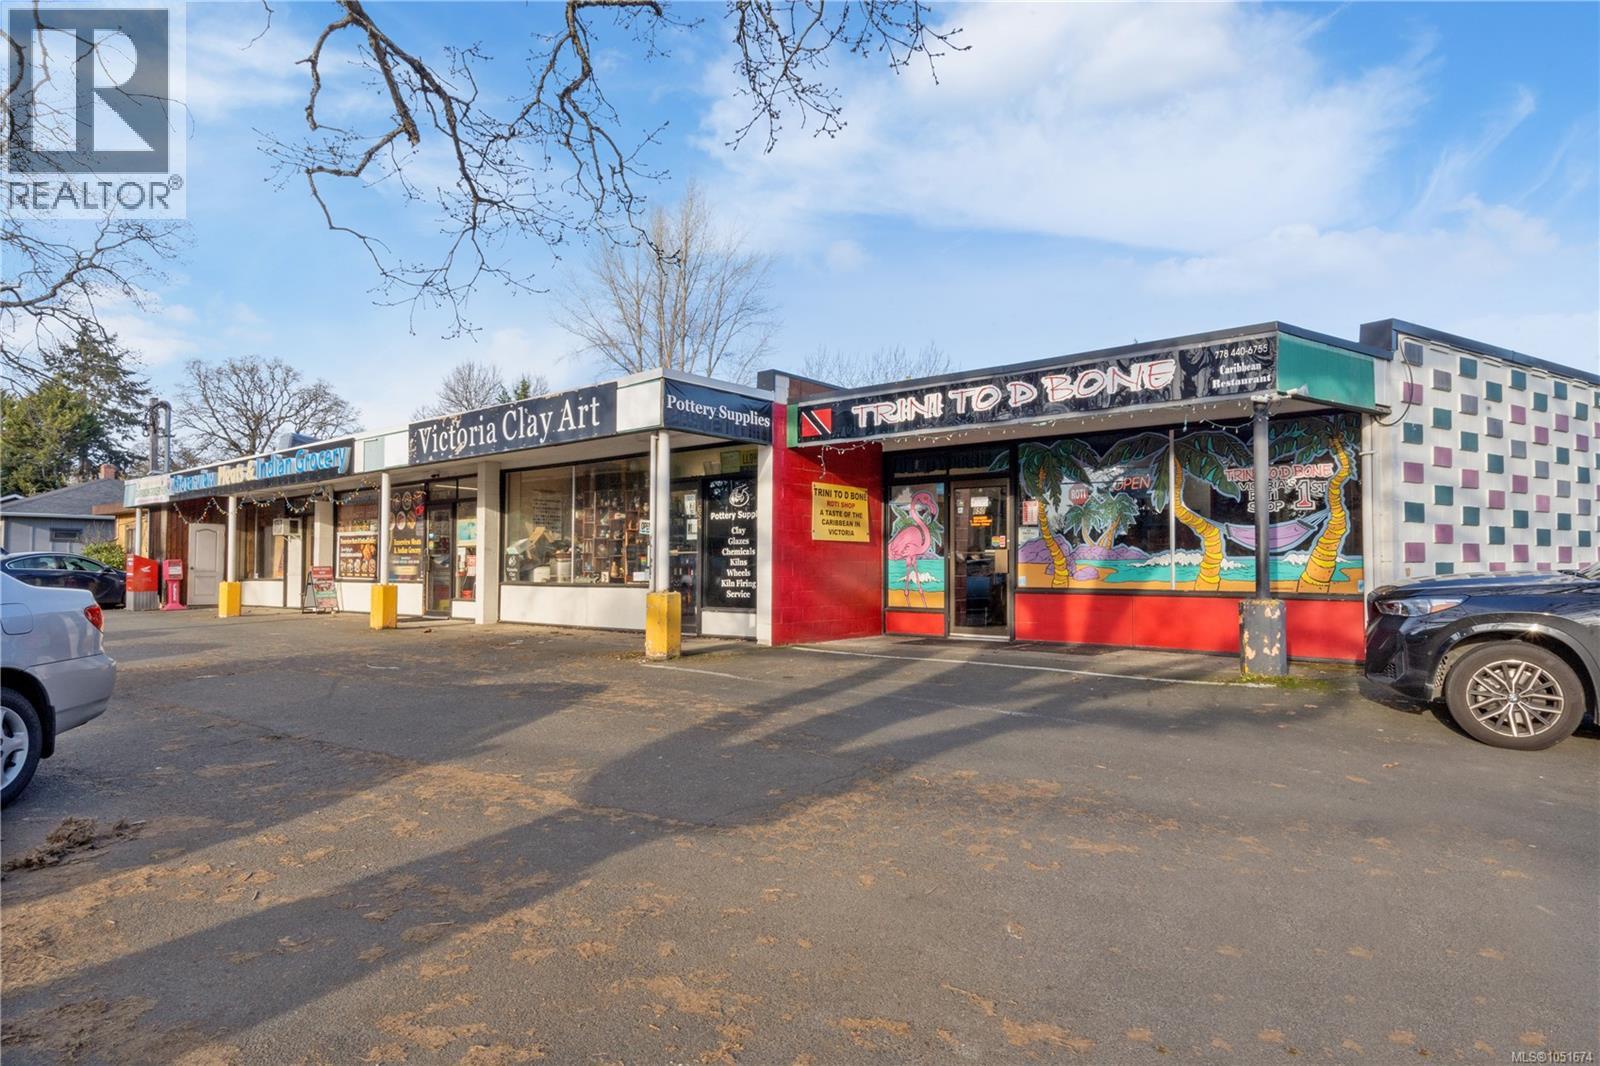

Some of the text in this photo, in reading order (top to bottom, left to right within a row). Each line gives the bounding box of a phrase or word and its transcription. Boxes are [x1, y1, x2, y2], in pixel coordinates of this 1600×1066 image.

[1214, 344, 1268, 359] 778 440-6755
[1219, 362, 1262, 375] Caribbean
[1212, 374, 1272, 389] Restaurant
[852, 359, 1176, 428] TRINI TO D BONE
[666, 394, 771, 427] Pottery Supplies
[418, 396, 600, 454] Victoria Clay Art
[255, 452, 294, 480] Indian
[295, 447, 350, 474] Grocery
[1224, 468, 1256, 481] TRIN
[1292, 463, 1334, 478] BONE
[1113, 475, 1151, 491] OPEN
[814, 488, 867, 501] TRINI TO D BONE
[825, 509, 843, 517] TASTE
[1247, 500, 1285, 513] SOP
[710, 512, 736, 520] Pottery
[821, 519, 853, 527] CARIBBEAN
[731, 527, 746, 535] Clay
[727, 537, 750, 545] Glazes
[721, 547, 756, 556] Chemicals
[730, 558, 748, 566] Kilns
[726, 568, 751, 577] Wheels
[721, 579, 757, 589] Kiln Firing
[726, 590, 751, 598] Service
